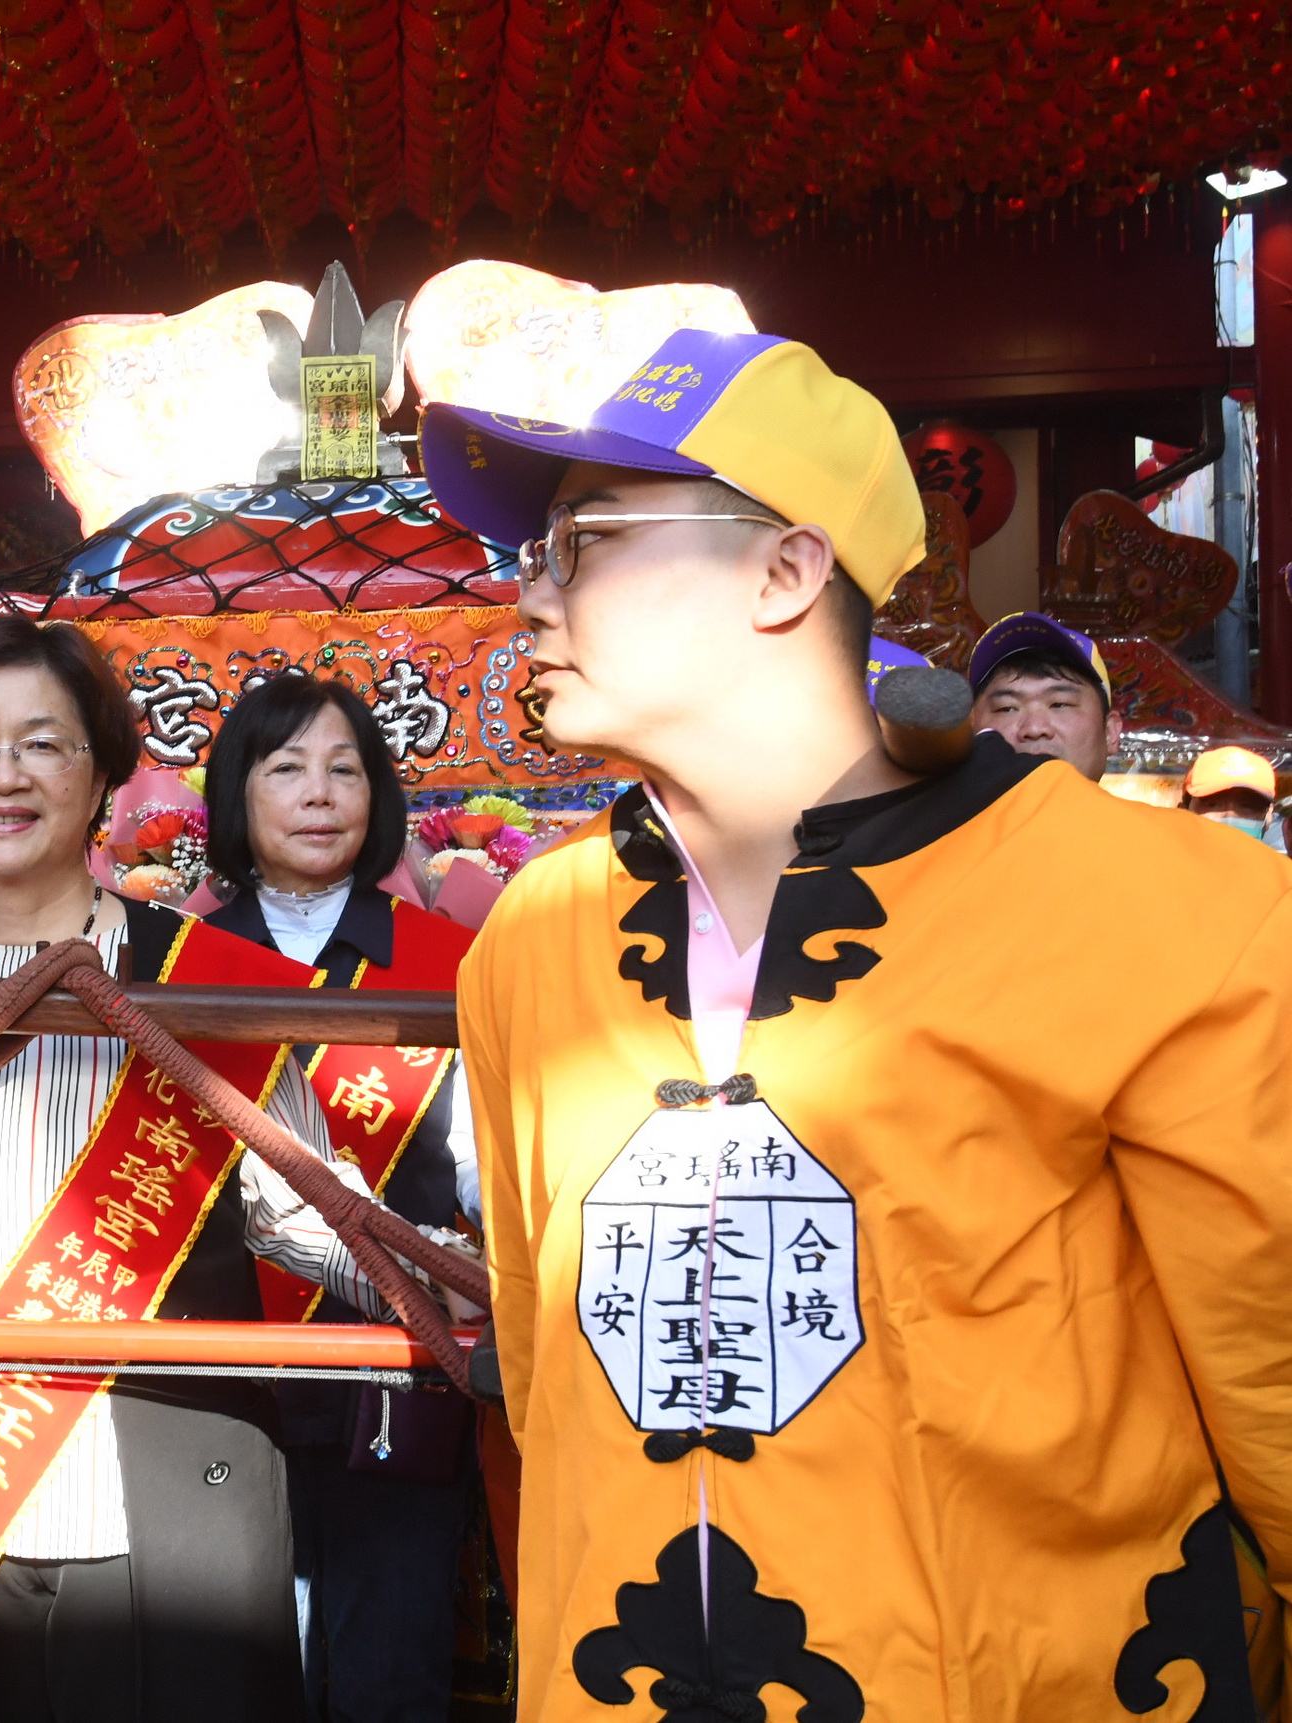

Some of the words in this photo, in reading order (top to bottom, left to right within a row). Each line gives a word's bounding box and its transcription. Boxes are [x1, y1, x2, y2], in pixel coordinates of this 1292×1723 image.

[94, 1114, 202, 1253] 南瑤宮
[629, 1135, 796, 1188] 南瑤宮
[54, 1230, 139, 1296] 甲辰年
[589, 1220, 645, 1337] 平安
[647, 1216, 765, 1420] 天上聖母
[780, 1217, 846, 1341] 合境
